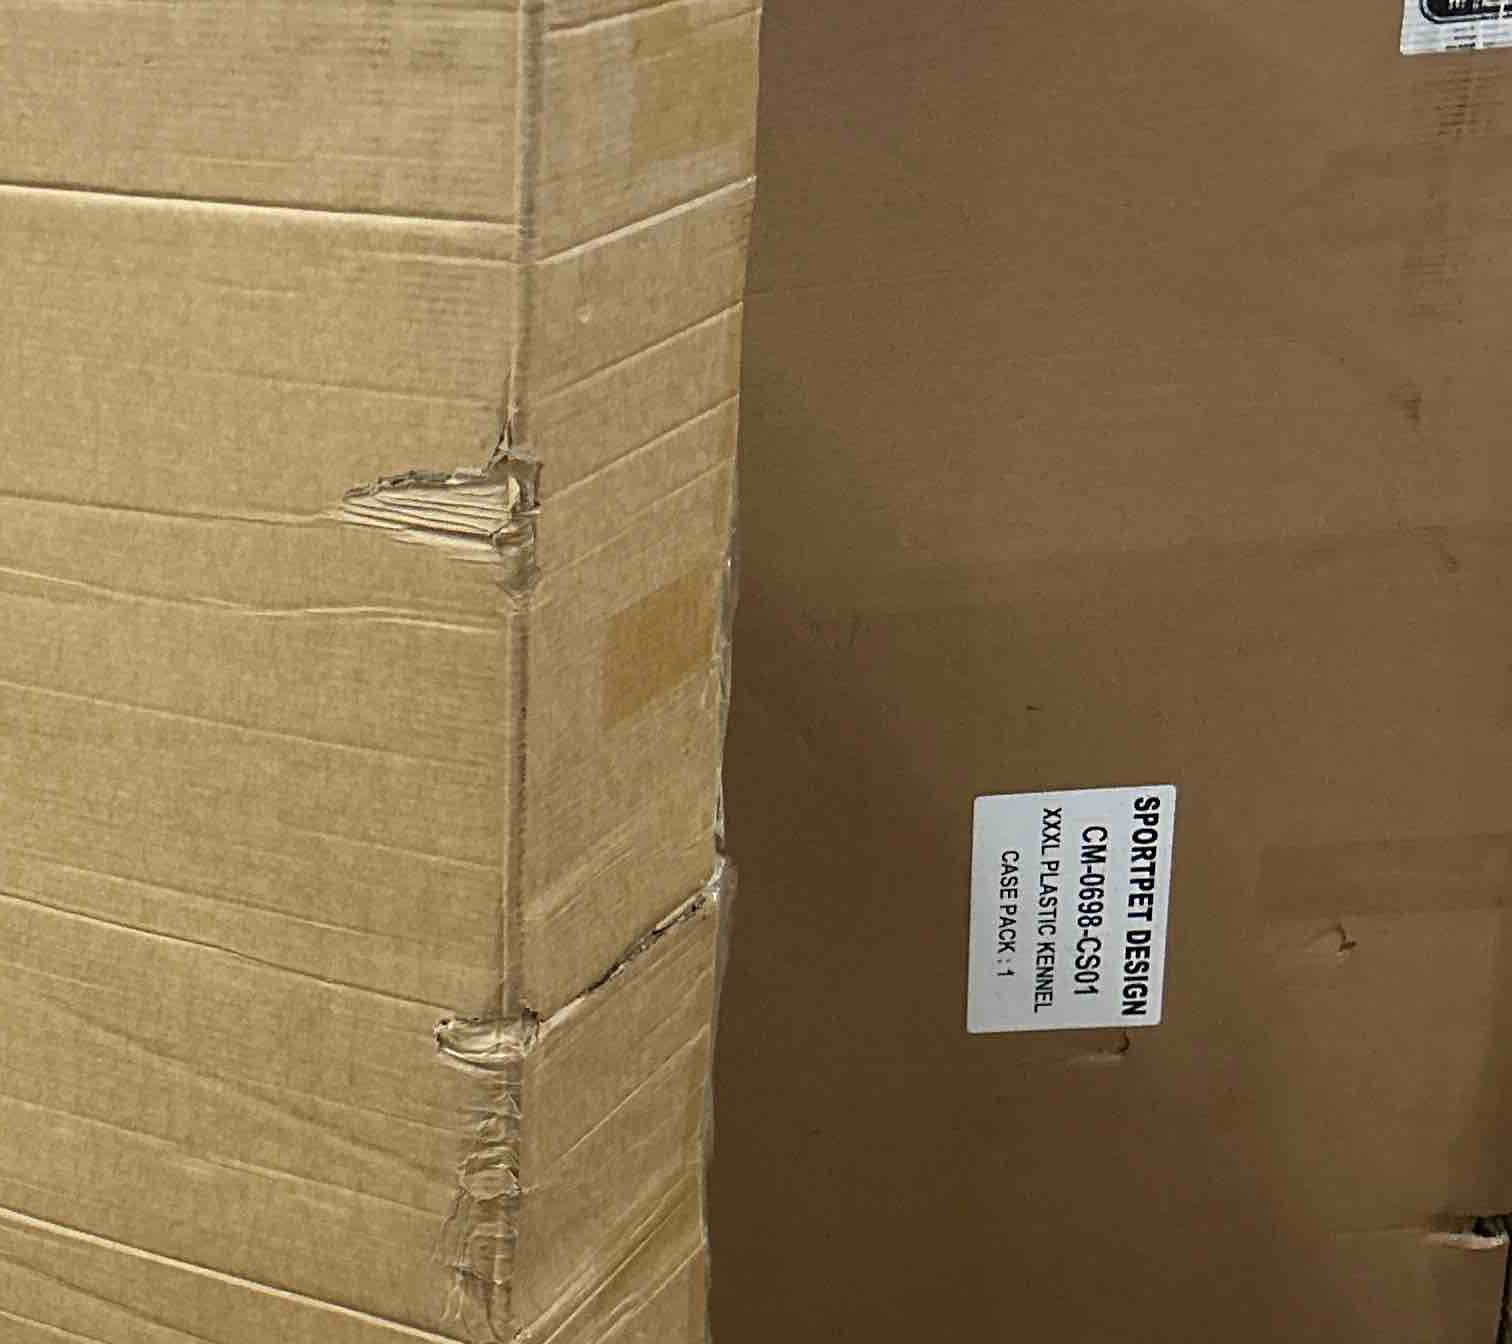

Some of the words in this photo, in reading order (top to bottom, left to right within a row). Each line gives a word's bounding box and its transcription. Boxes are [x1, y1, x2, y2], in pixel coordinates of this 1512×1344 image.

[1041, 807, 1063, 856] XXXL
[1126, 796, 1161, 923] SPORTPET
[999, 849, 1020, 901] CASE
[1037, 859, 1061, 937] PLASTIC
[1073, 825, 1109, 995] CM-0698-CS01
[997, 903, 1017, 954] PACK
[1033, 941, 1056, 1014] KENNEL
[1121, 929, 1152, 1017] DESIGN
